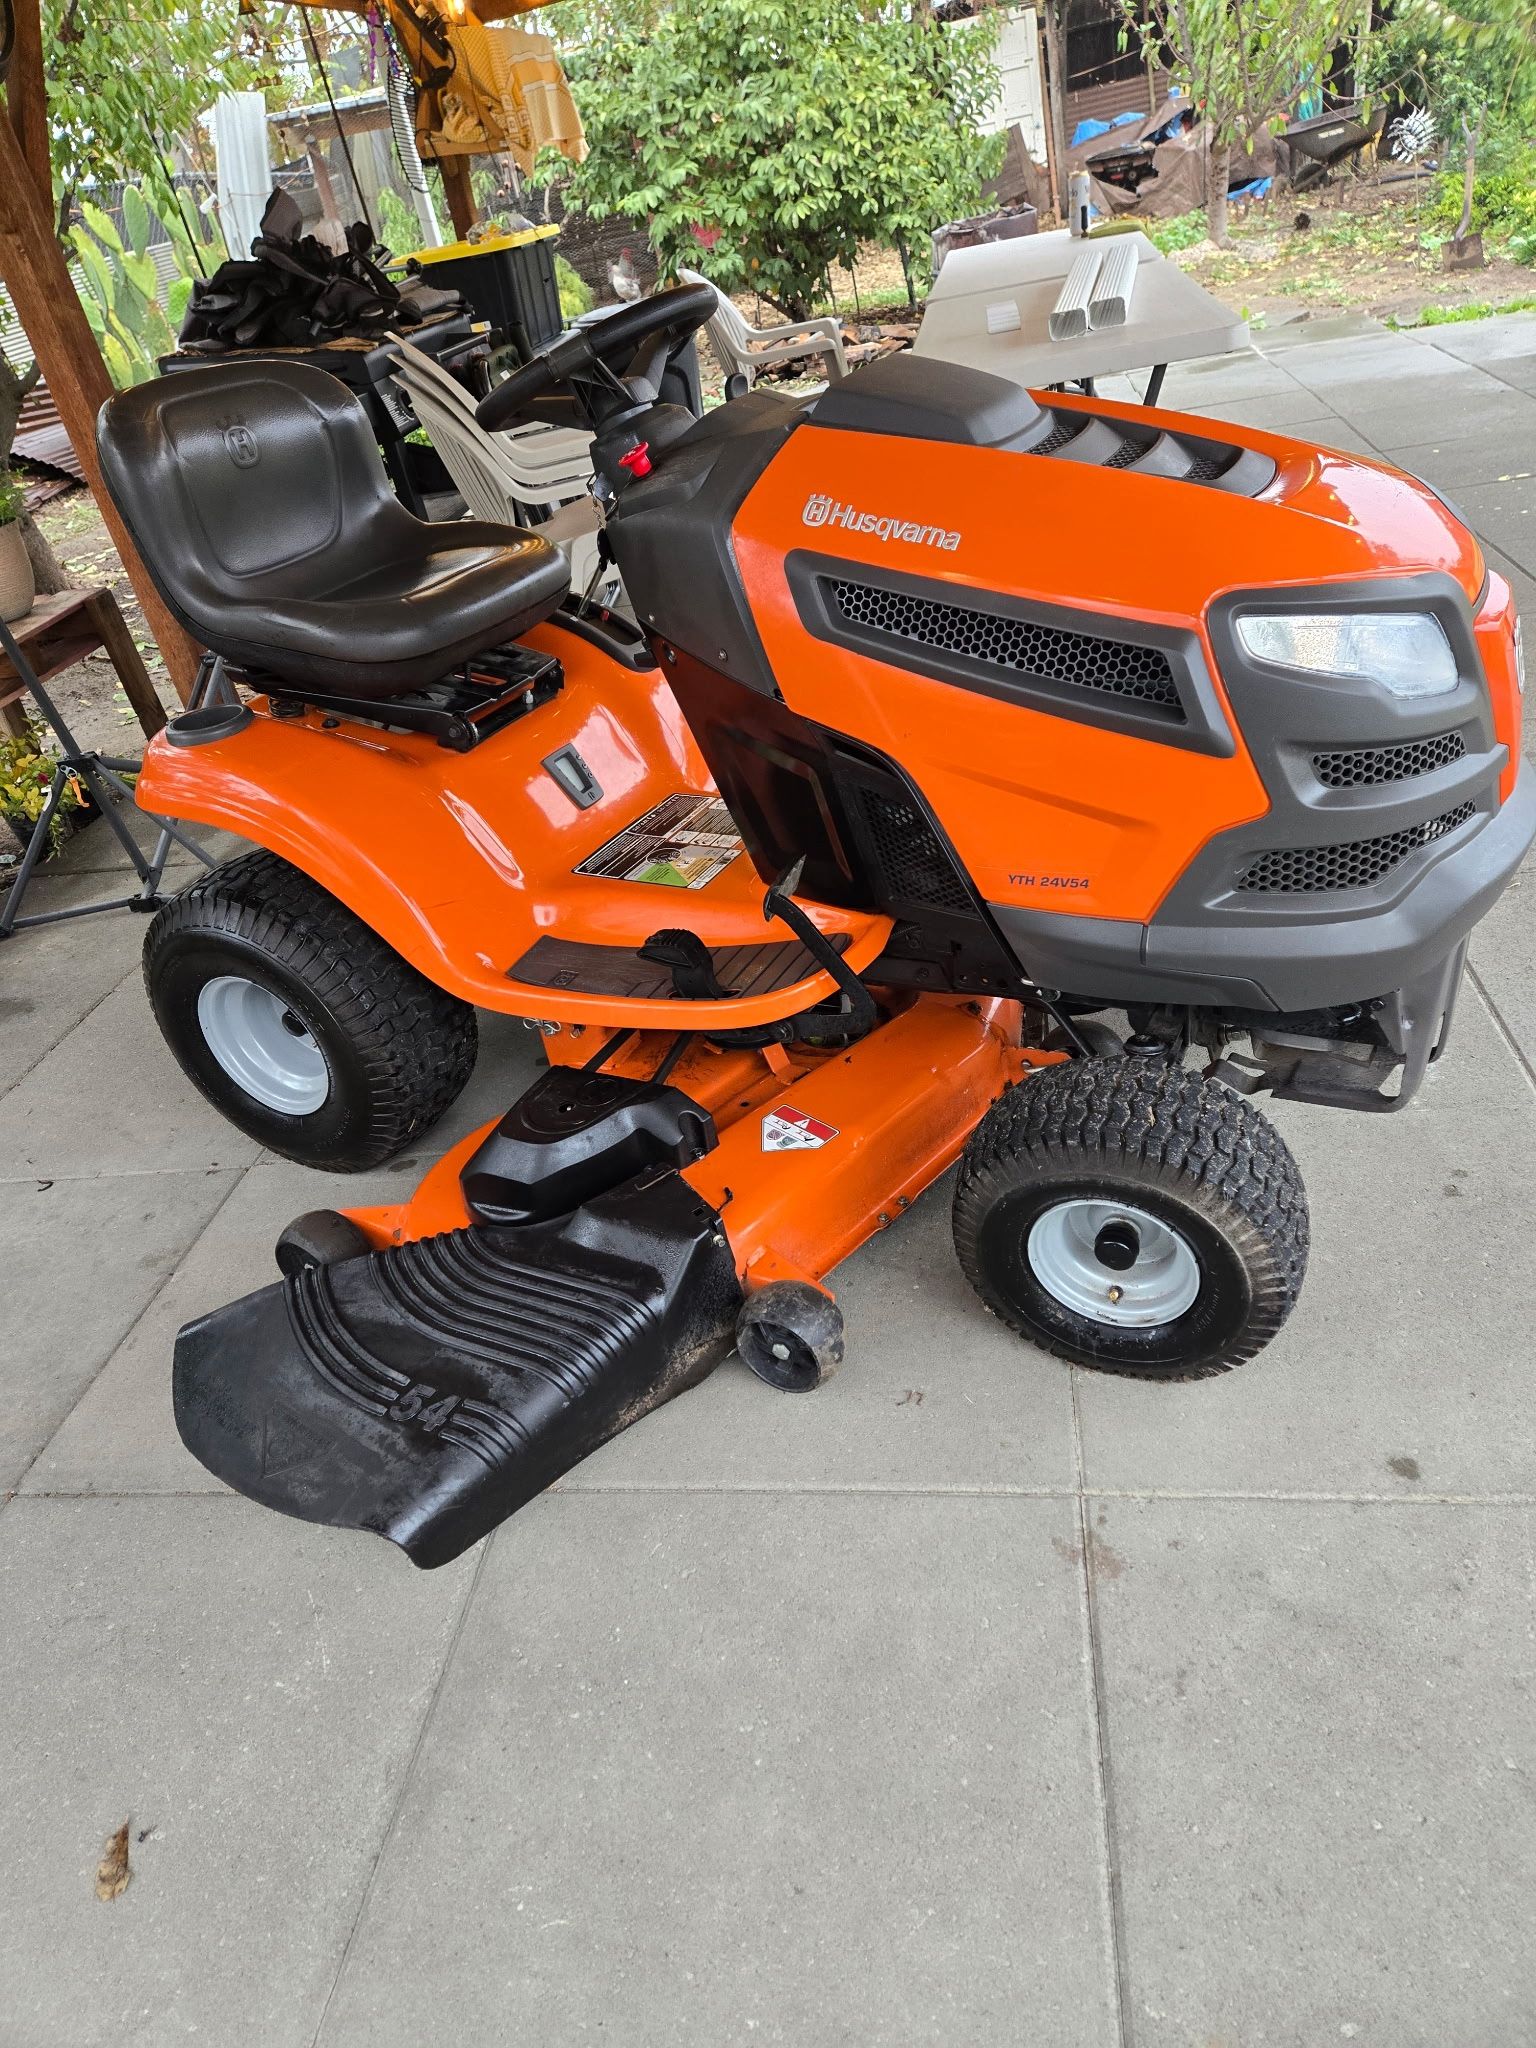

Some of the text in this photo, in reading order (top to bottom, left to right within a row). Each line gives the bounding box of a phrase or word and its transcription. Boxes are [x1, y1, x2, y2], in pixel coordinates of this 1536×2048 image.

[828, 501, 962, 551] Husqvarna
[1008, 874, 1090, 889] YTH 24V54
[389, 1383, 461, 1432] 54
